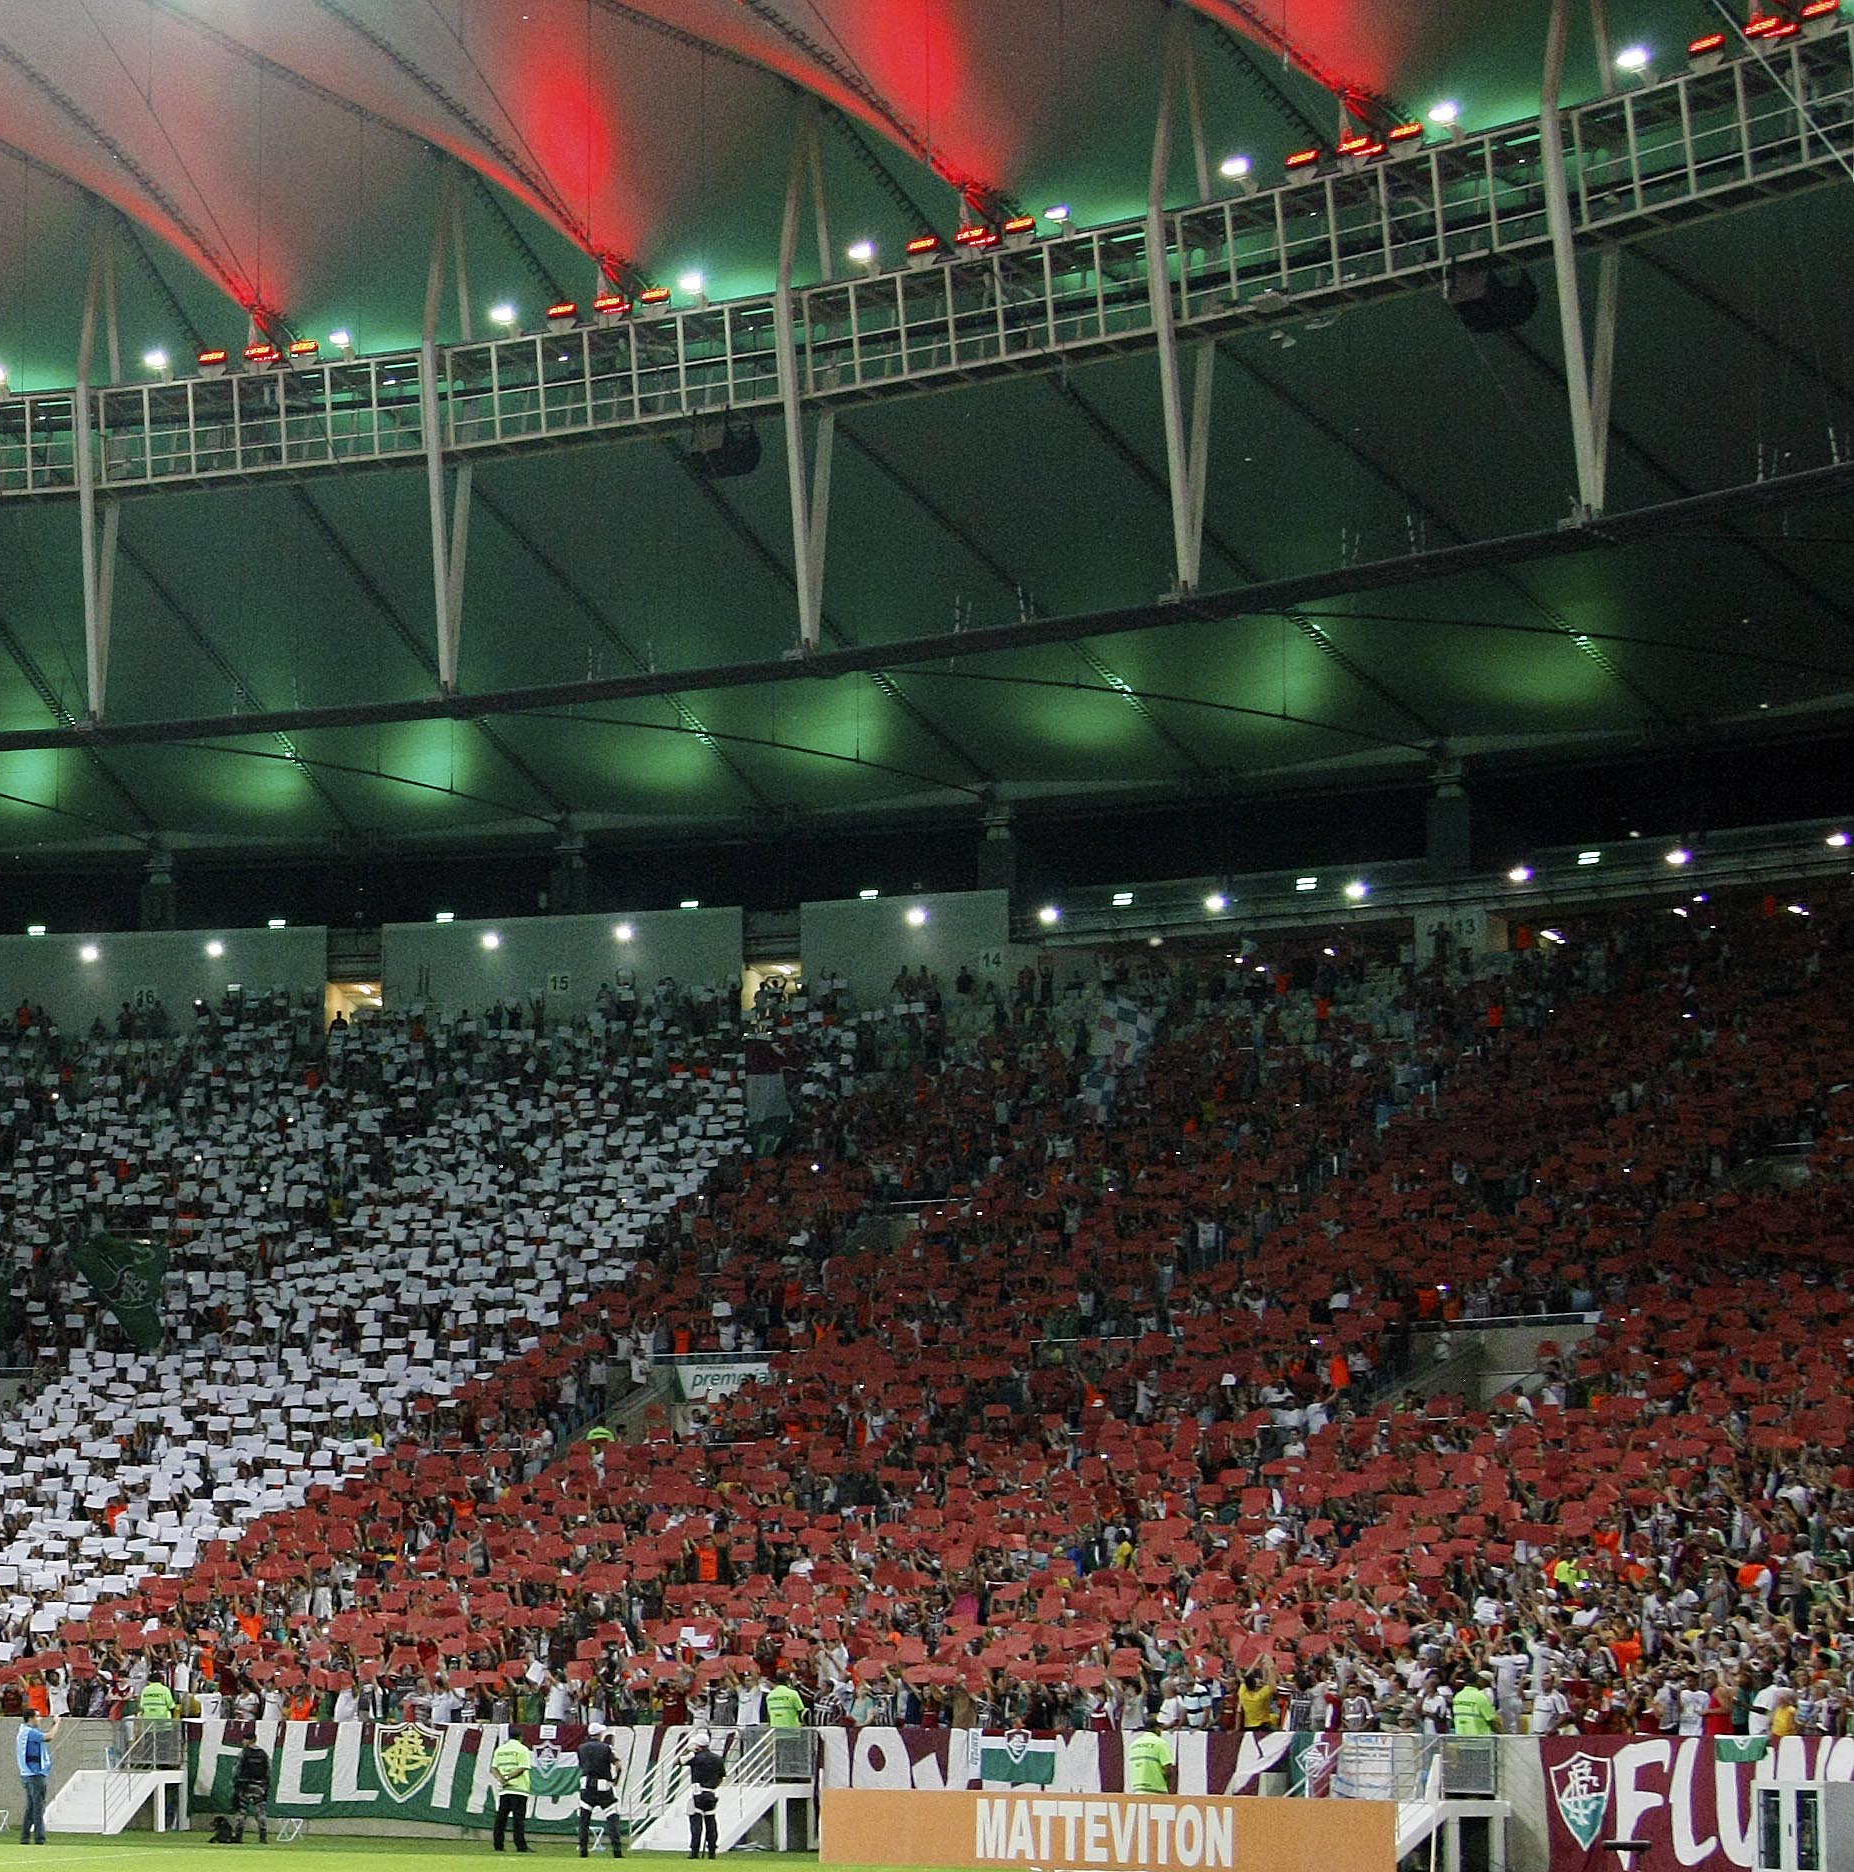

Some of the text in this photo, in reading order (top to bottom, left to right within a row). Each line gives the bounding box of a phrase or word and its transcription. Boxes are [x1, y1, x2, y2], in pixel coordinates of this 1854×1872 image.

[983, 951, 1003, 968] 14
[550, 975, 569, 990] 15
[211, 1700, 220, 1715] 7
[975, 1798, 1234, 1868] MATTEVITON
